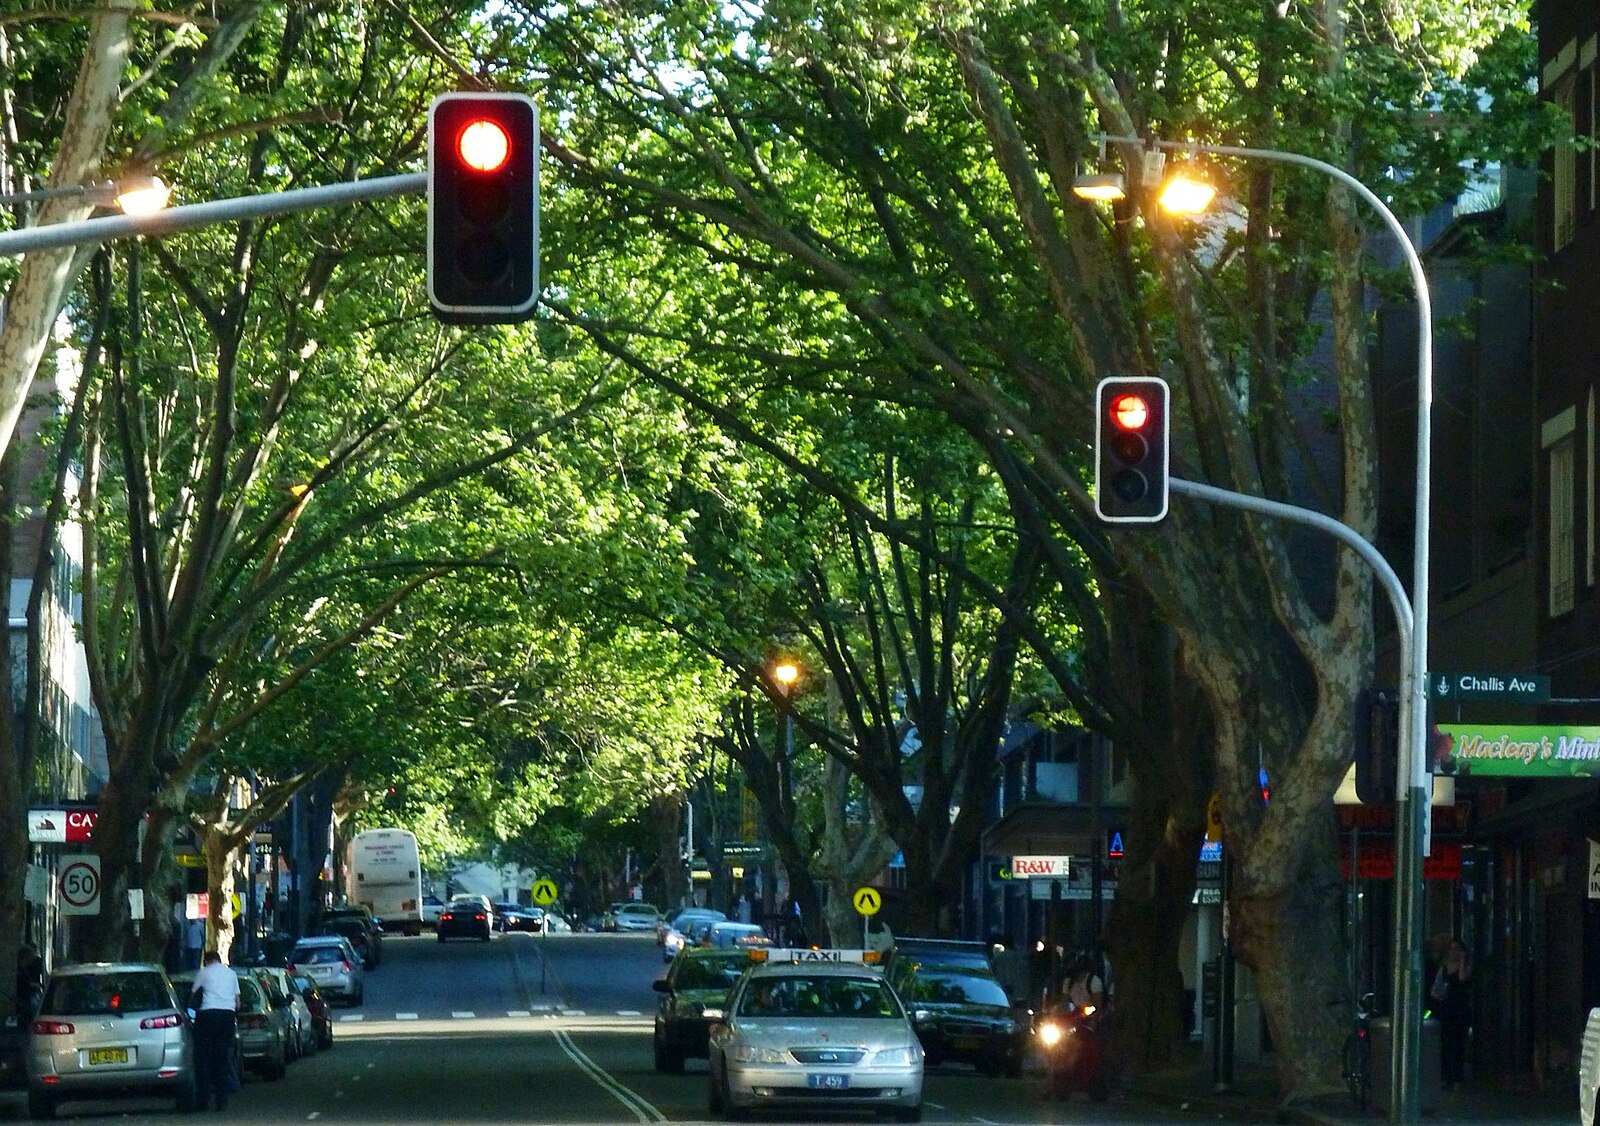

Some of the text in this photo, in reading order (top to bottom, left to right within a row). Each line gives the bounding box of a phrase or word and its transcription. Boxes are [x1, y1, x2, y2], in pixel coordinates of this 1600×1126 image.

[1459, 676, 1536, 692] Challis Ave
[1014, 860, 1055, 873] R&W
[69, 875, 94, 895] 50
[793, 951, 837, 961] TAXI
[815, 1074, 842, 1087] T 459
